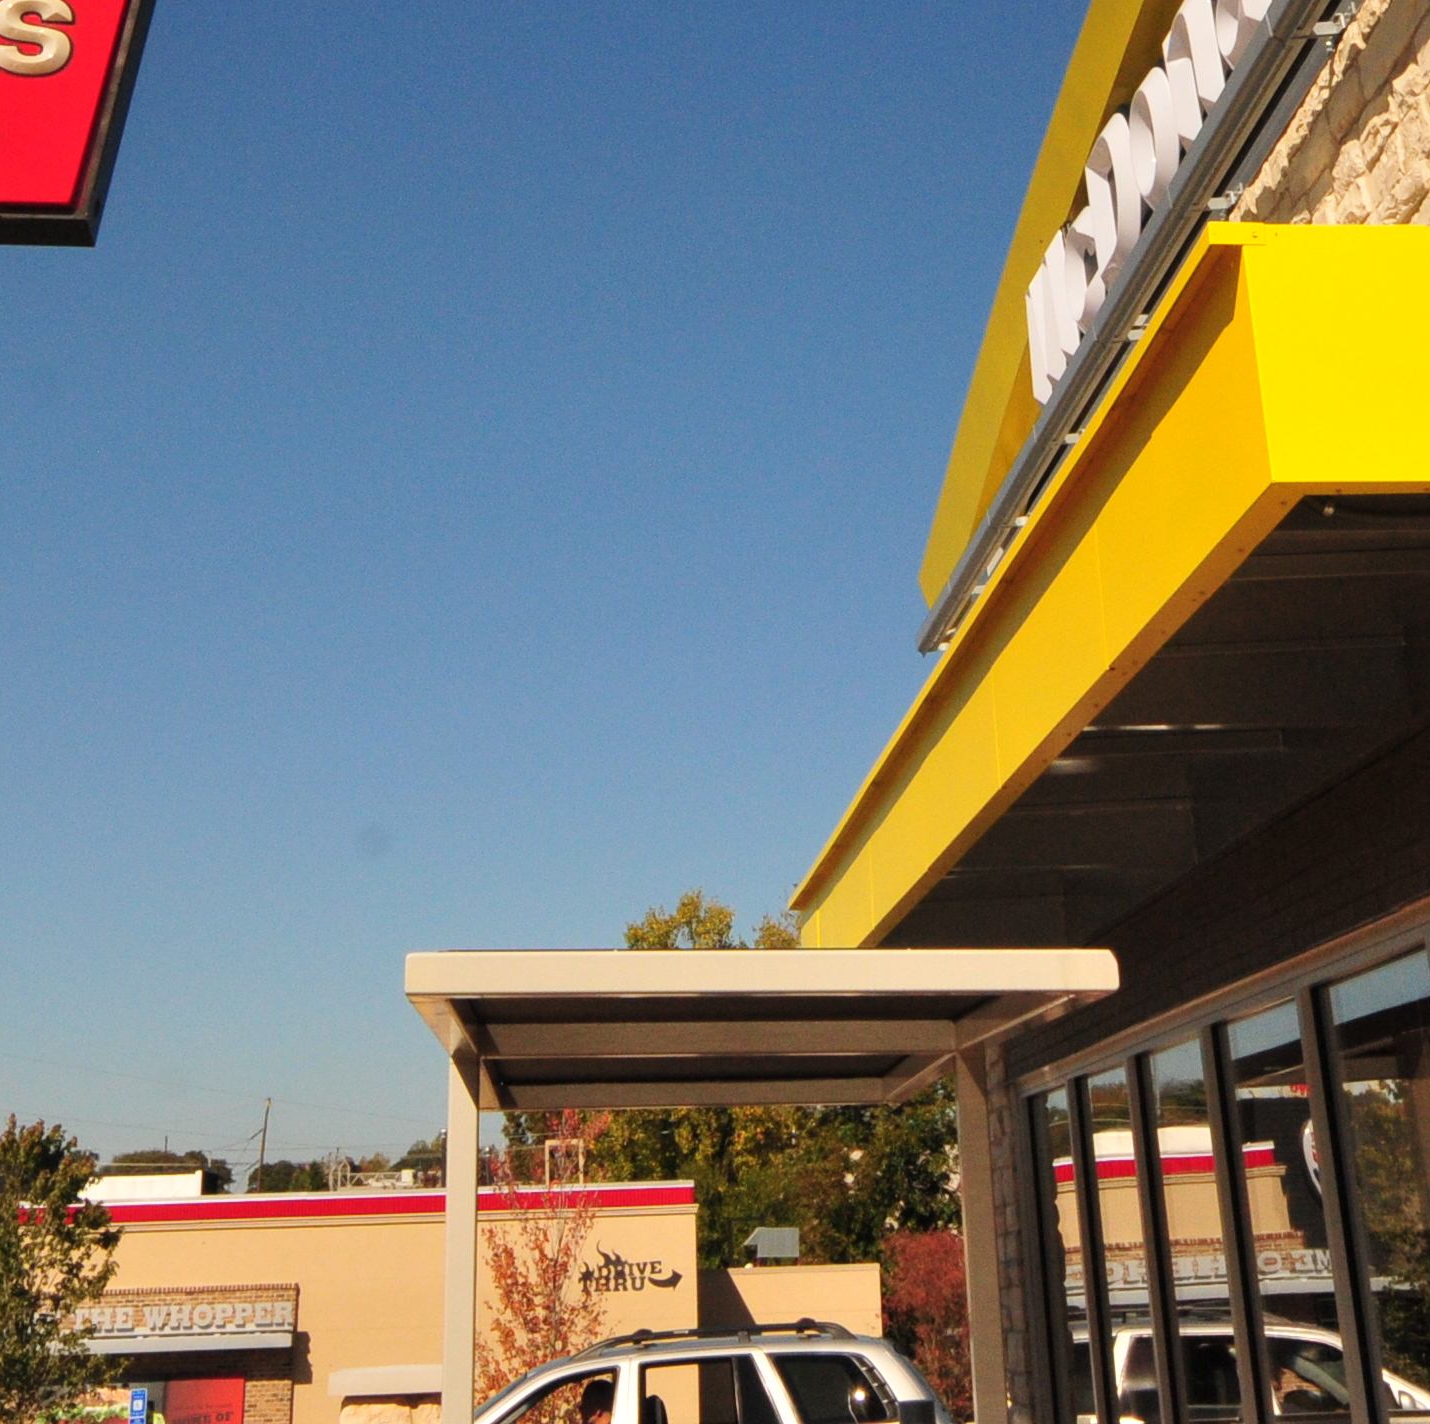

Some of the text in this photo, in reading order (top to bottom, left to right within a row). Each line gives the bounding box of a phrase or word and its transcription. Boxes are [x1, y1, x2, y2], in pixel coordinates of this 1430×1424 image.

[597, 1260, 662, 1278] DRIVE
[578, 1276, 646, 1292] THRU
[72, 1307, 134, 1334] THE
[142, 1301, 295, 1331] WHOPPER
